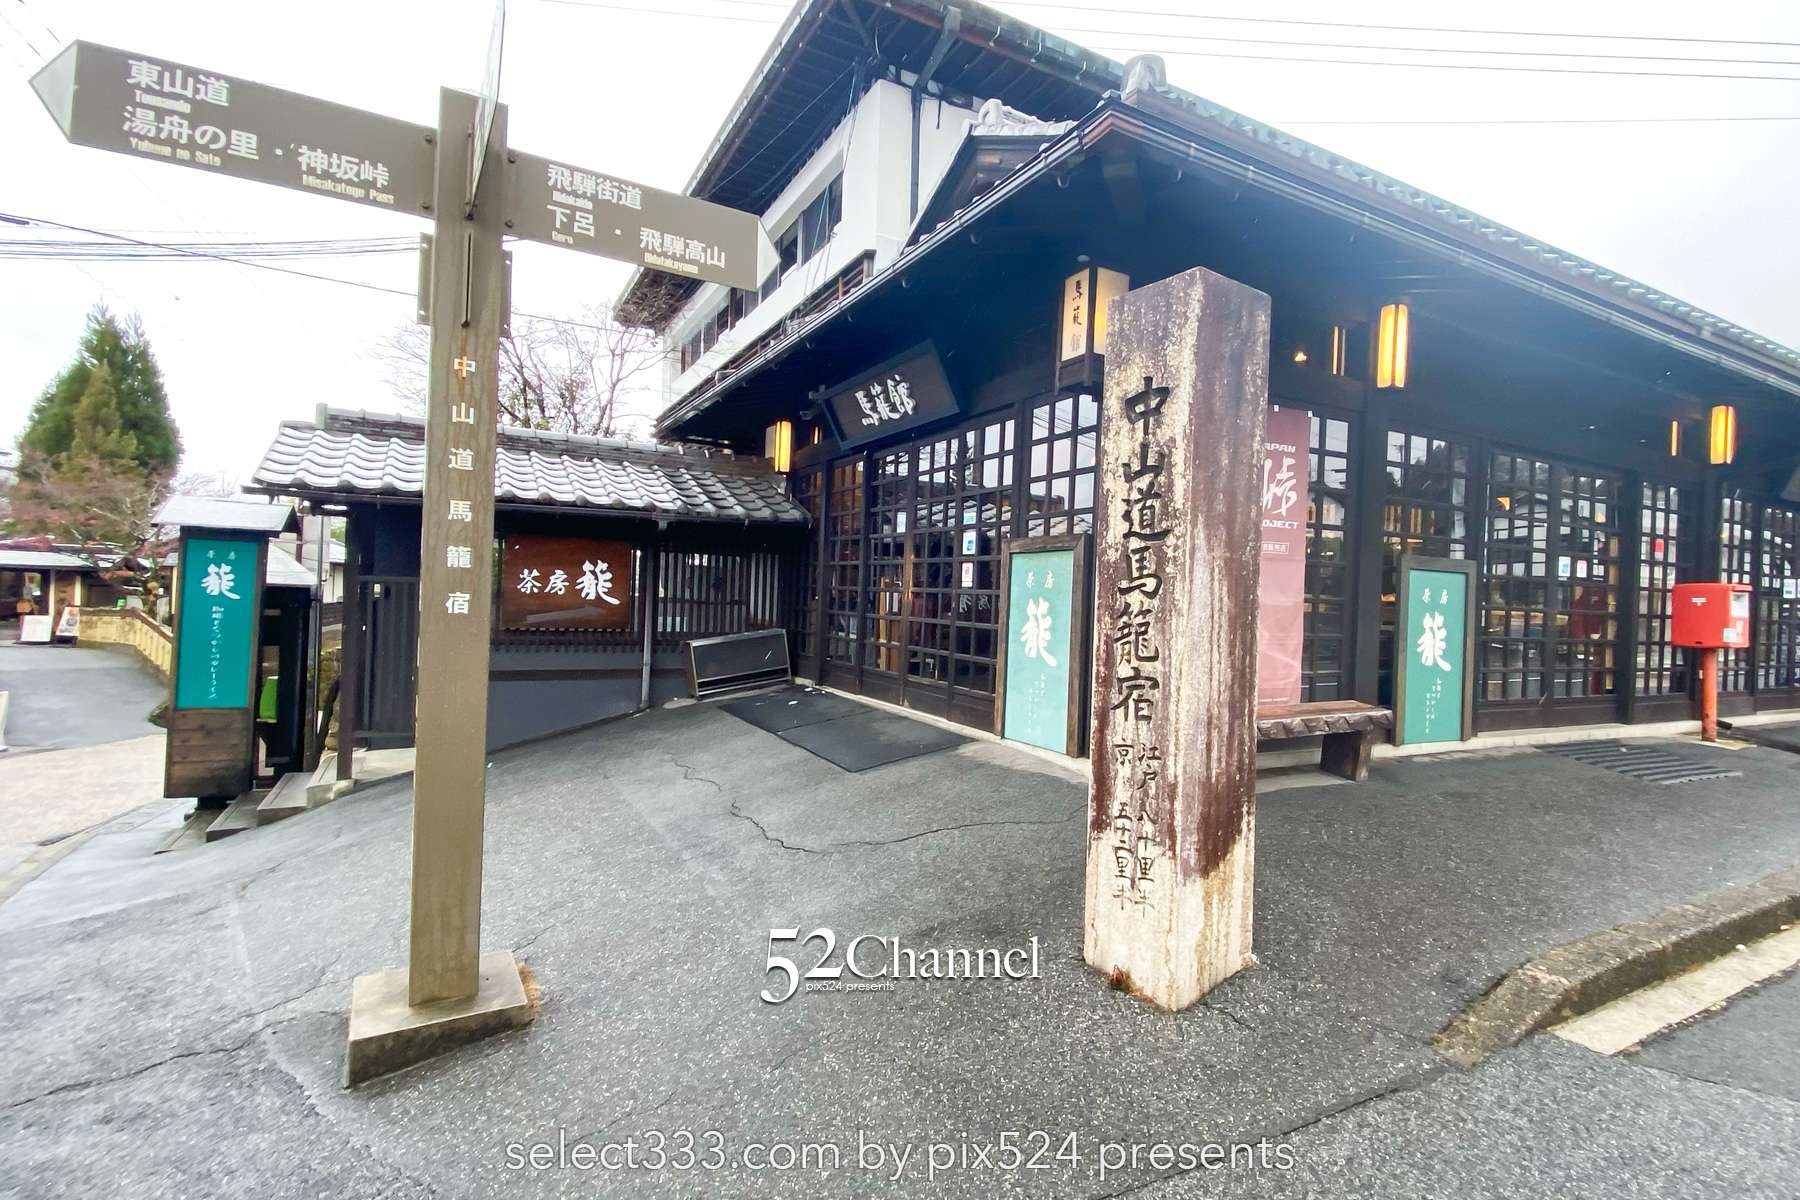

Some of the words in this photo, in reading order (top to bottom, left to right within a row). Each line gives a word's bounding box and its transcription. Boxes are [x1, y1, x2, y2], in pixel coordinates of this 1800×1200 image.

[126, 59, 230, 106] 東山道
[122, 105, 260, 160] 湯舟の里
[298, 144, 390, 188] 神坂峠
[546, 204, 595, 238] 下呂
[1262, 442, 1296, 454] APAN
[445, 354, 476, 616] 中山道馬籠宿
[1261, 519, 1299, 530] OJECT
[1110, 375, 1172, 723] 中山道馬籠宿
